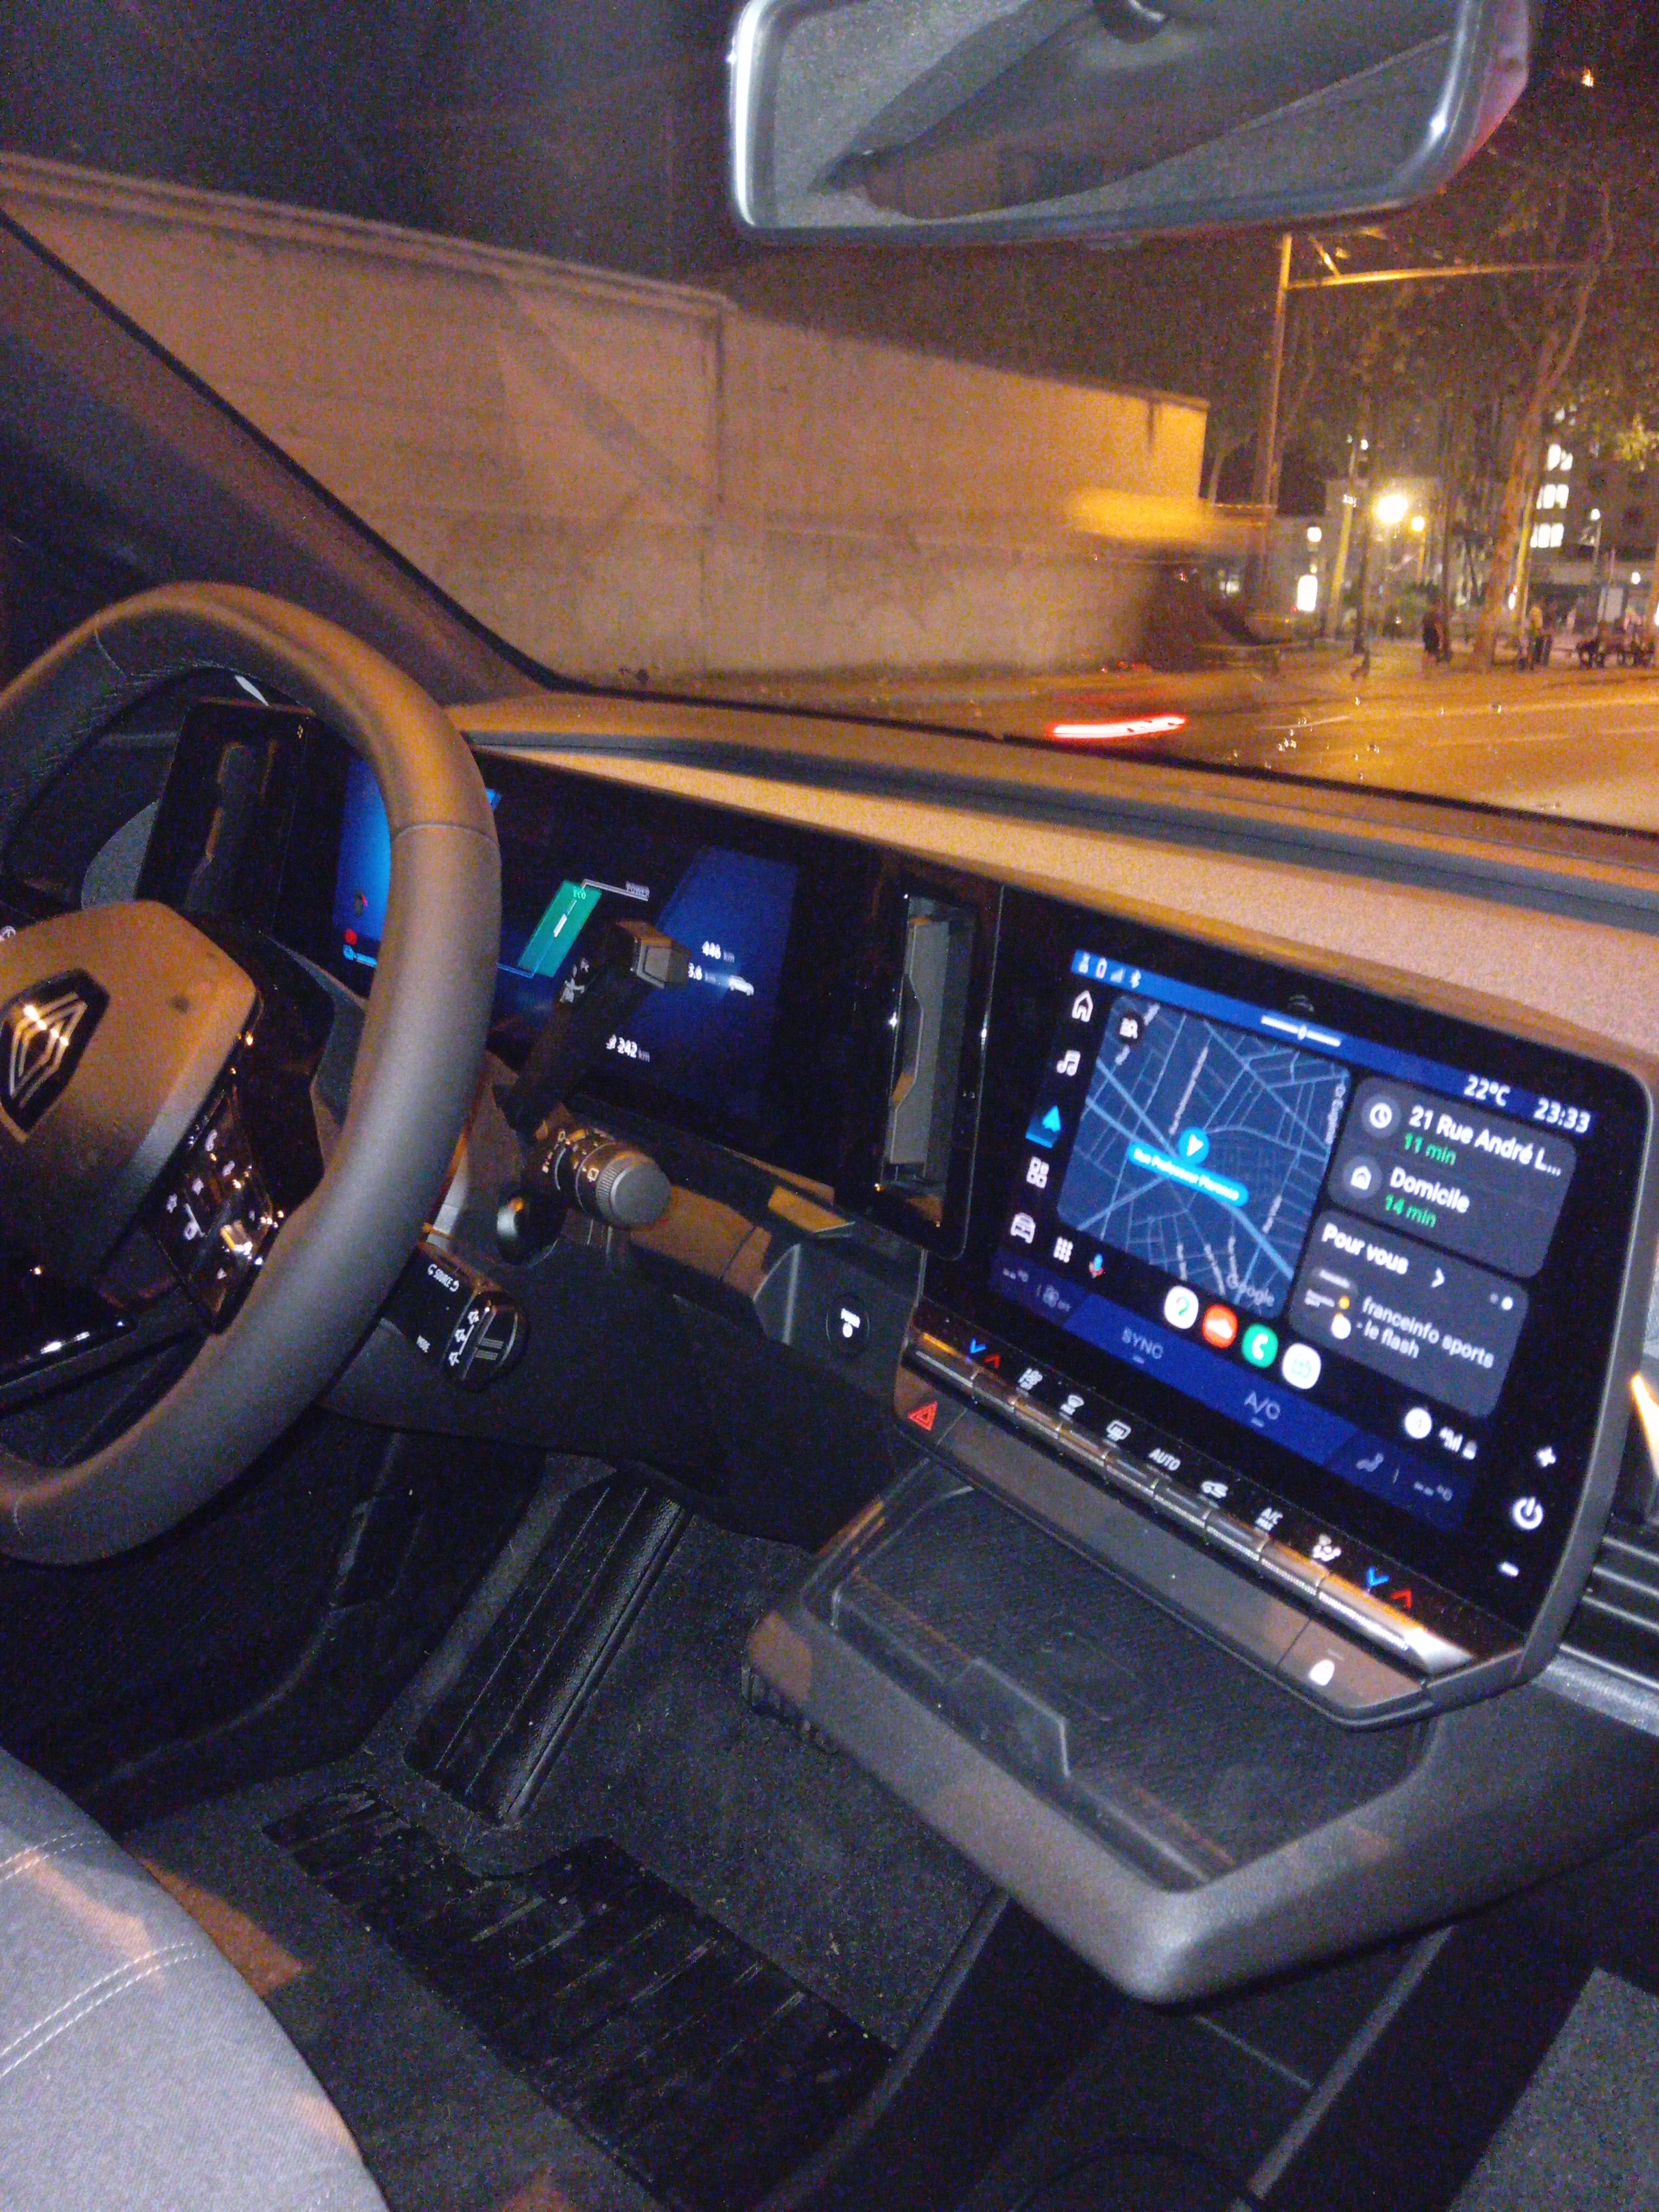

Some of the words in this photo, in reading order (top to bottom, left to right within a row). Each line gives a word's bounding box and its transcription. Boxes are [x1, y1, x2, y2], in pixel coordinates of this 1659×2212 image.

[1534, 1097, 1591, 1134] 23:33
[1404, 1133, 1423, 1154] 11
[1425, 1142, 1457, 1166] min
[1409, 1105, 1432, 1130] 21
[1436, 1114, 1473, 1144] Rue
[1474, 1129, 1534, 1166] André
[1390, 1167, 1471, 1213] Domicile
[1385, 1194, 1405, 1216] 14
[1406, 1205, 1437, 1228] min
[1321, 1223, 1365, 1256] Pour
[1366, 1243, 1409, 1275] vous
[434, 1268, 454, 1288] SOURCE
[1361, 1295, 1441, 1345] franceinfo
[1442, 1334, 1495, 1369] sports
[1363, 1319, 1379, 1341] le
[1380, 1327, 1420, 1359] flash
[1148, 1448, 1181, 1471] AUTO
